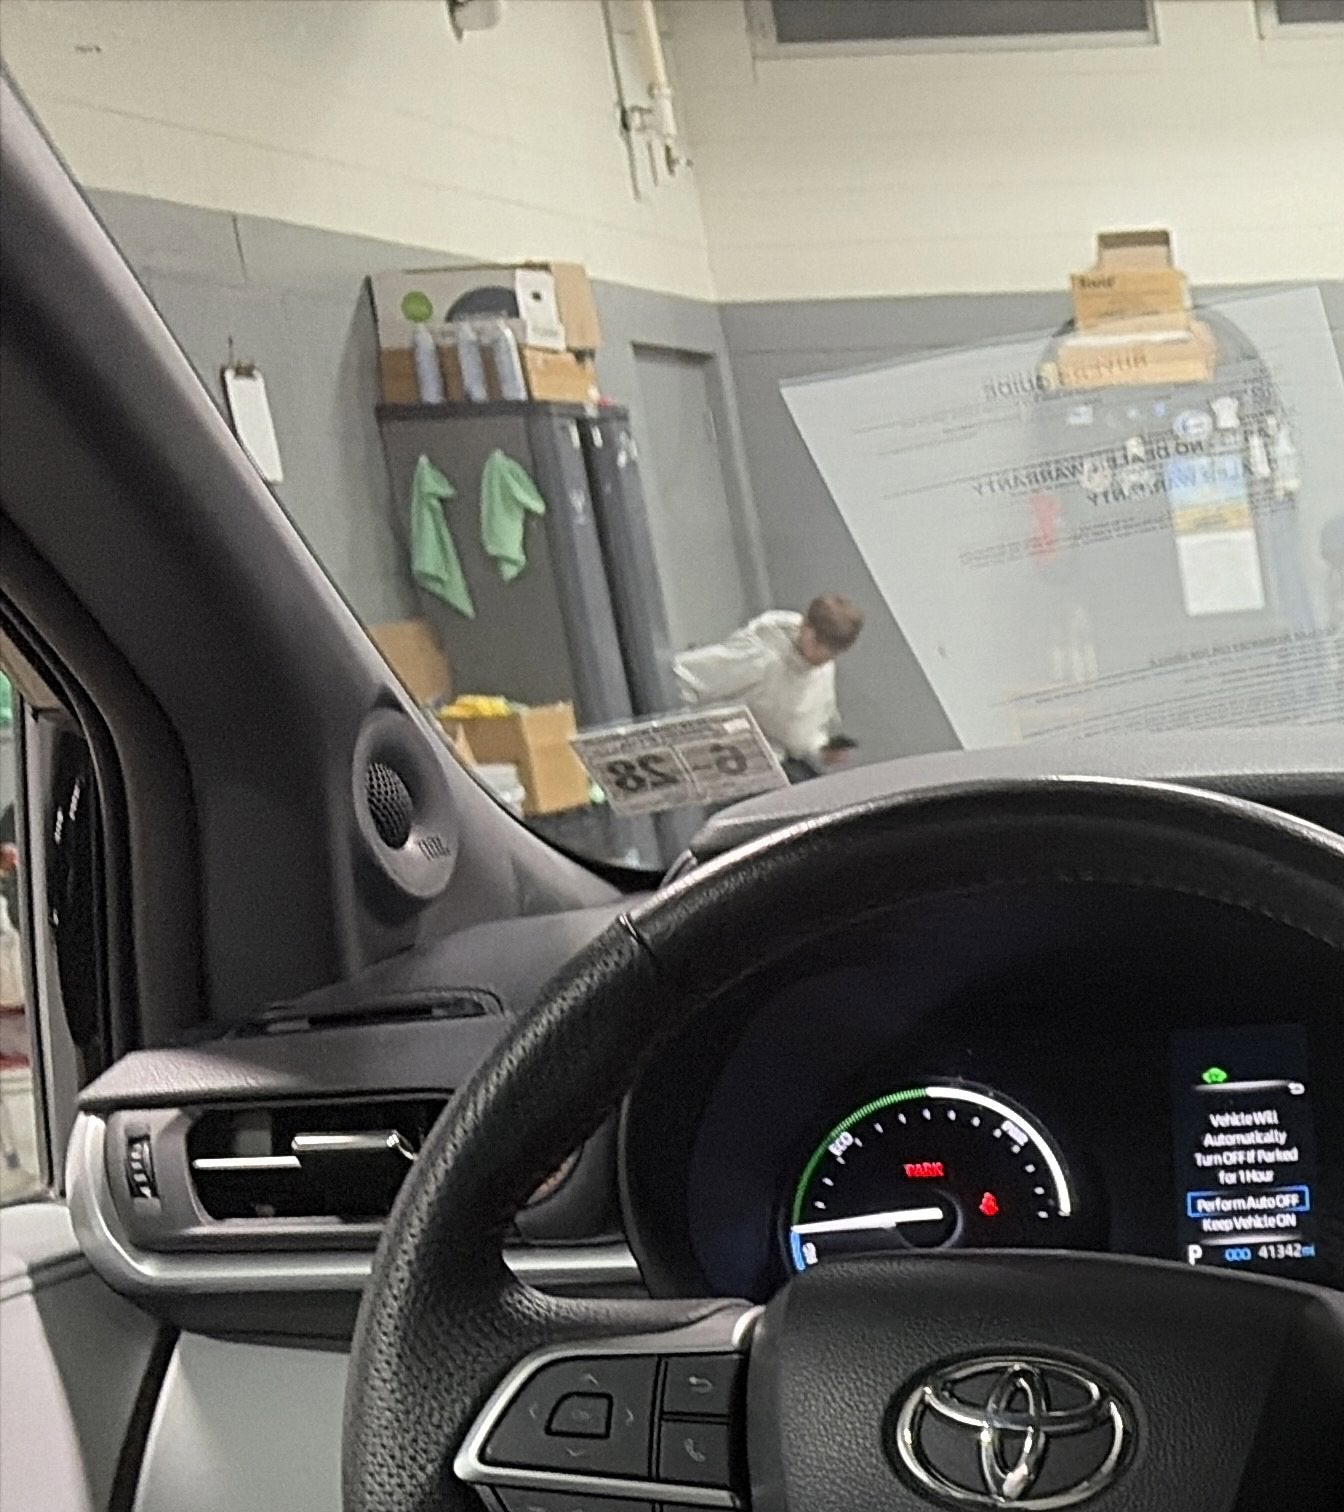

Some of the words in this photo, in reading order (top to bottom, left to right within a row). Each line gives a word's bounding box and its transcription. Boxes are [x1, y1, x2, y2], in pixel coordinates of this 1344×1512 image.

[1209, 1112, 1253, 1128] Vehicle
[1253, 1109, 1279, 1125] Will
[828, 1130, 853, 1157] ECO
[1203, 1129, 1287, 1148] Automatically
[1194, 1152, 1223, 1167] Turn
[1223, 1150, 1245, 1165] OFF
[1257, 1146, 1298, 1162] Parked
[903, 1161, 944, 1178] PARK
[1218, 1170, 1237, 1184] for
[1246, 1168, 1274, 1183] Hour
[1196, 1197, 1245, 1213] Perform
[1245, 1196, 1275, 1210] Auto
[1275, 1193, 1299, 1208] OFF
[1202, 1217, 1233, 1233] Keep
[1233, 1215, 1275, 1231] Vehicle
[1275, 1213, 1297, 1227] ON
[1188, 1244, 1203, 1265] P
[1257, 1243, 1302, 1259] 41342
